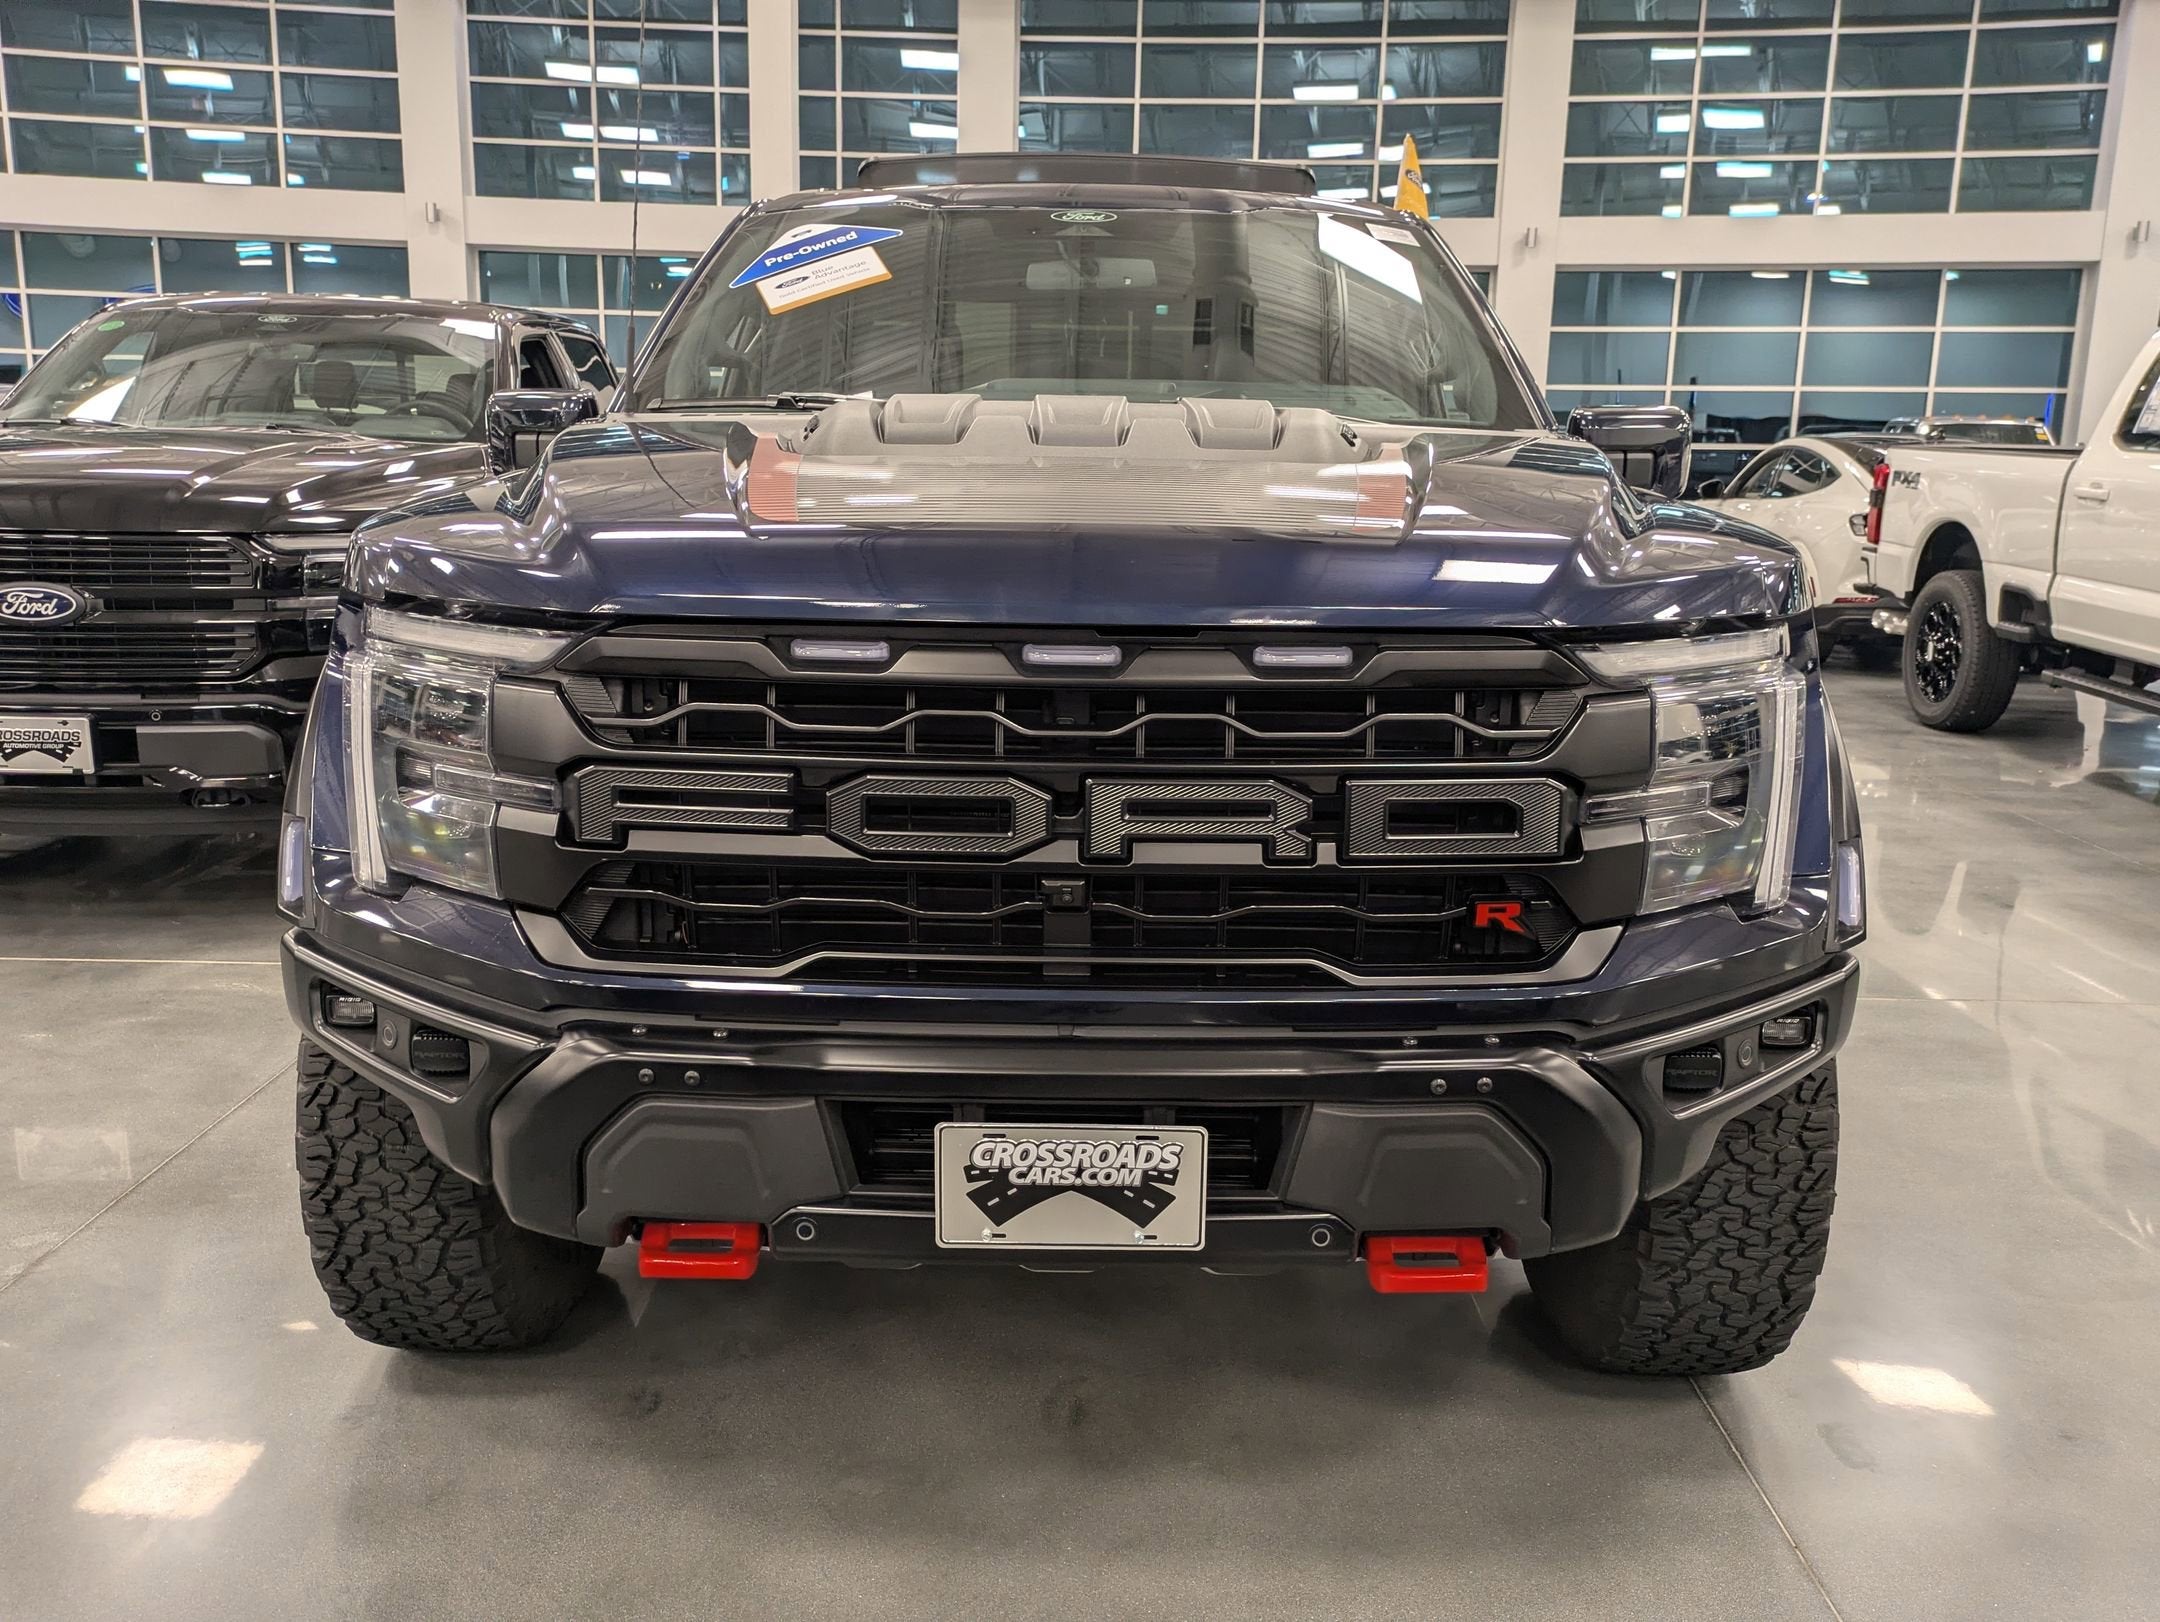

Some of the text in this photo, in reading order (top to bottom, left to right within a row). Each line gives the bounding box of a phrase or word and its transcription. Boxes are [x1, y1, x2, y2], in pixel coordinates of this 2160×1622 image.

[1062, 212, 1106, 221] Ford
[764, 231, 858, 267] Pre-Owned
[811, 265, 834, 275] Blue
[814, 261, 866, 279] Advantage
[1892, 470, 1921, 487] FX4
[2, 591, 58, 615] Ford
[0, 729, 81, 742] OSSROADS
[574, 765, 1568, 860] FORD
[1475, 902, 1526, 933] R
[414, 1050, 465, 1060] RAPTOR
[970, 1139, 1184, 1170] CROSSROADS
[1008, 1166, 1144, 1187] CARS.COM
